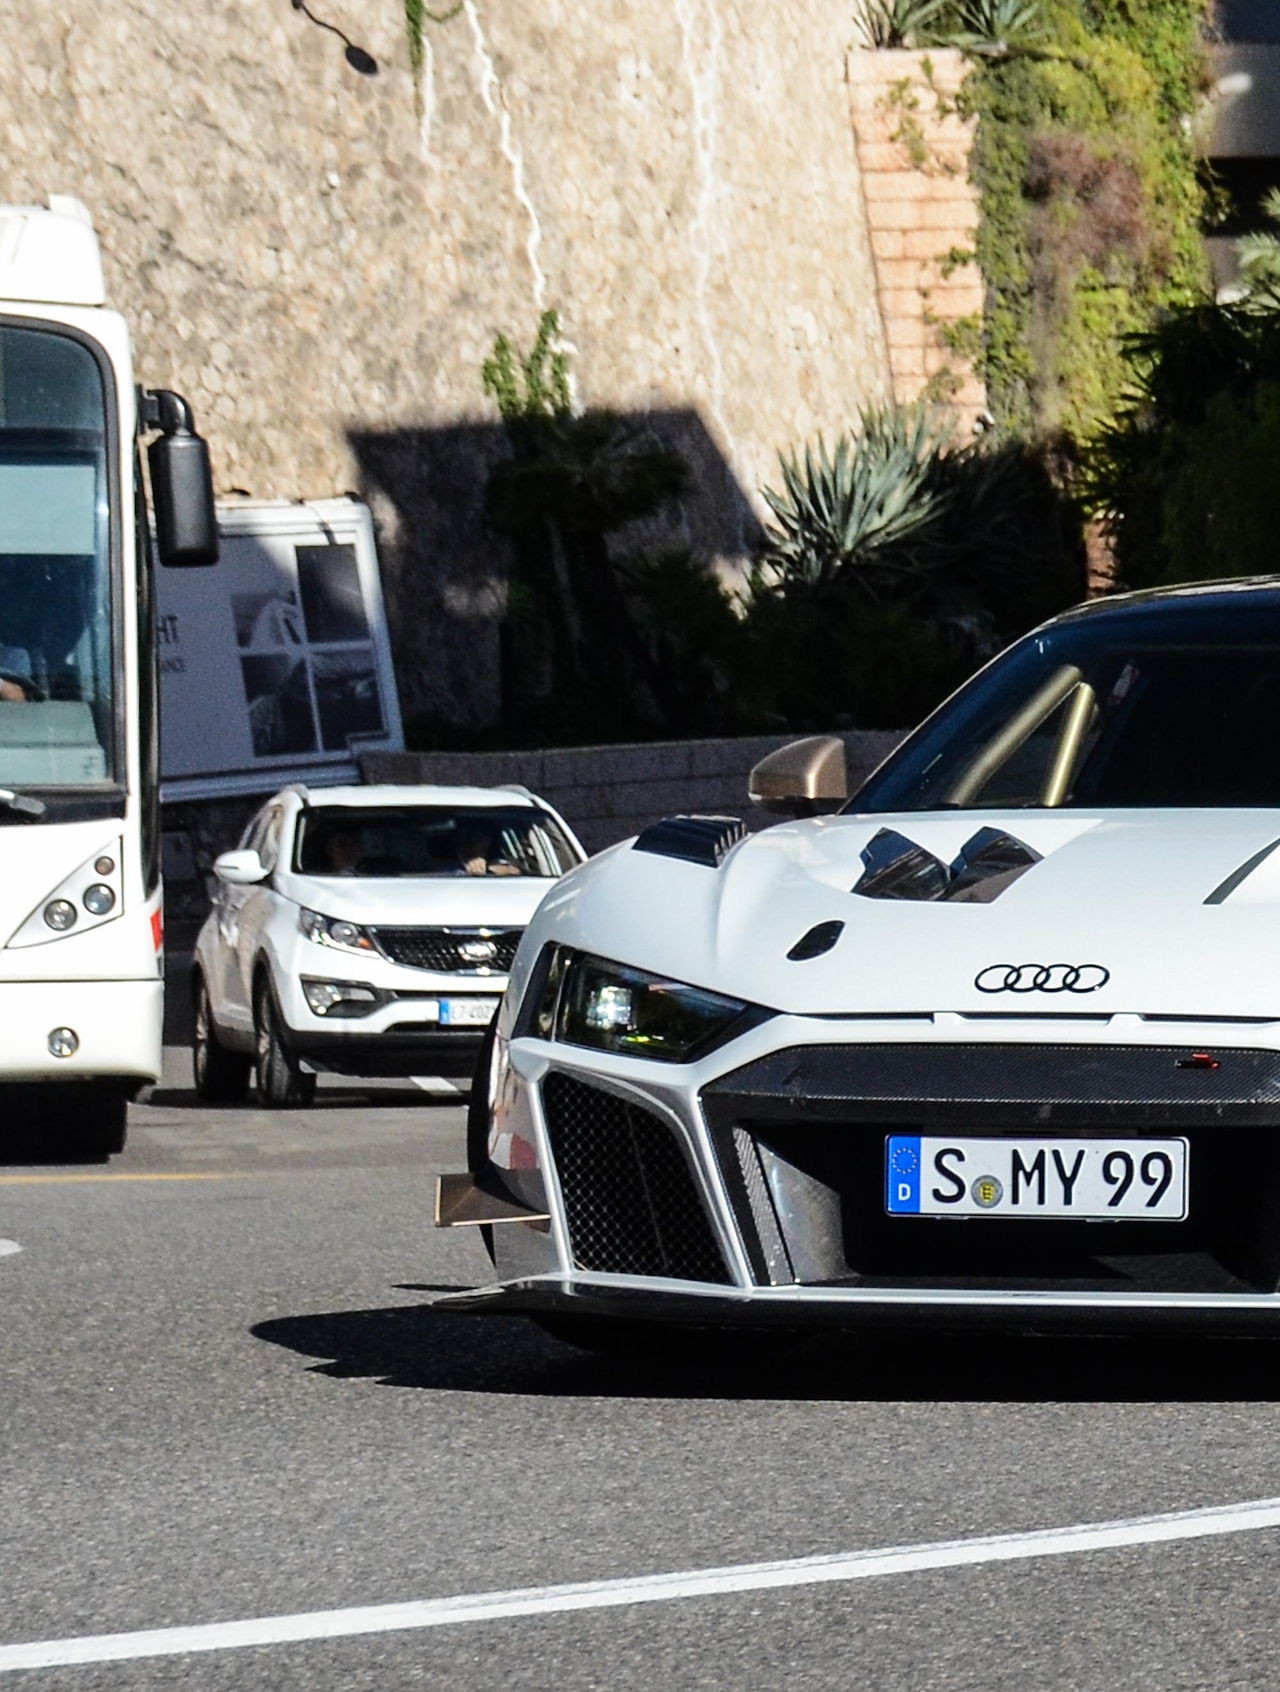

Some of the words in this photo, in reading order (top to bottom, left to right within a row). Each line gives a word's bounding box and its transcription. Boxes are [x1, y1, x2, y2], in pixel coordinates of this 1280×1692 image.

[898, 1183, 911, 1201] D
[932, 1148, 966, 1203] S
[1011, 1149, 1085, 1206] MY
[1102, 1151, 1173, 1207] 99
